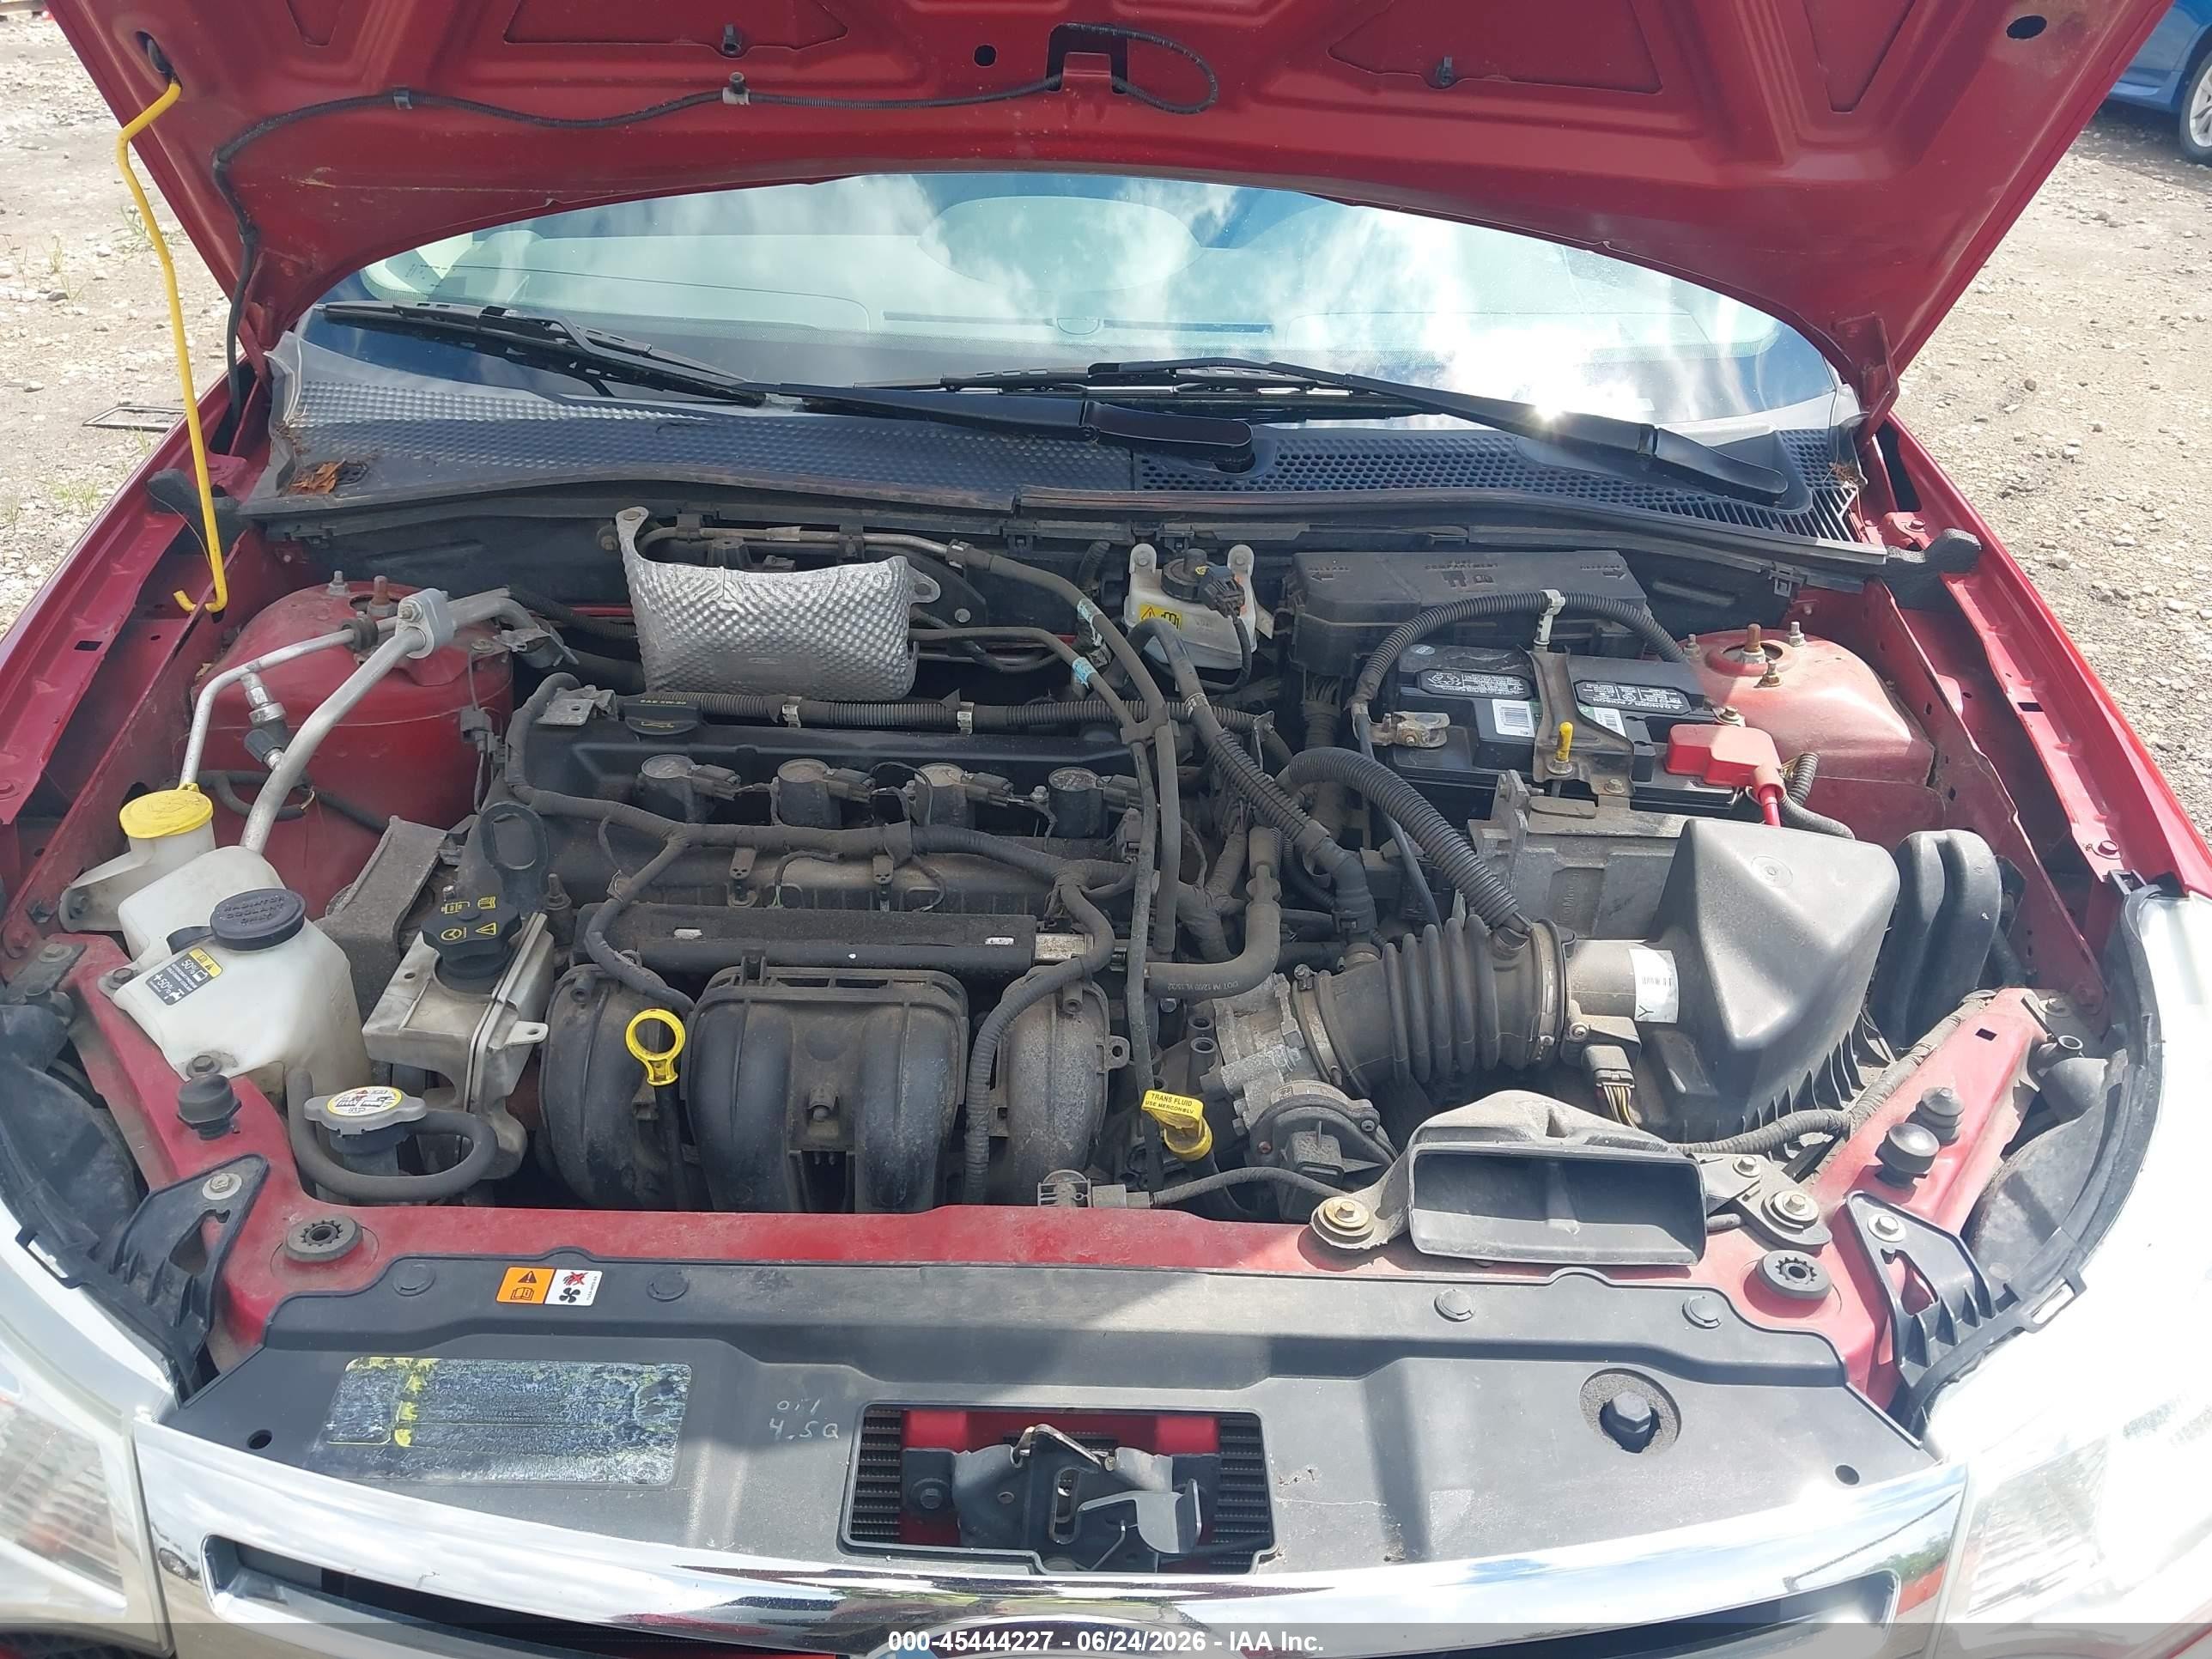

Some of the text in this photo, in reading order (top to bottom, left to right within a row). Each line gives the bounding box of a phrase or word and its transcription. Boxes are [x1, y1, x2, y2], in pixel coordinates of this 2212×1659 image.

[1592, 696, 1627, 707] POISON
[223, 895, 285, 913] RADIATOR
[225, 902, 284, 919] COOLANT
[240, 912, 272, 926] ONLY
[181, 959, 198, 974] 50%
[1638, 1004, 1655, 1018] Y
[1151, 1092, 1193, 1107] TRANS FLUID
